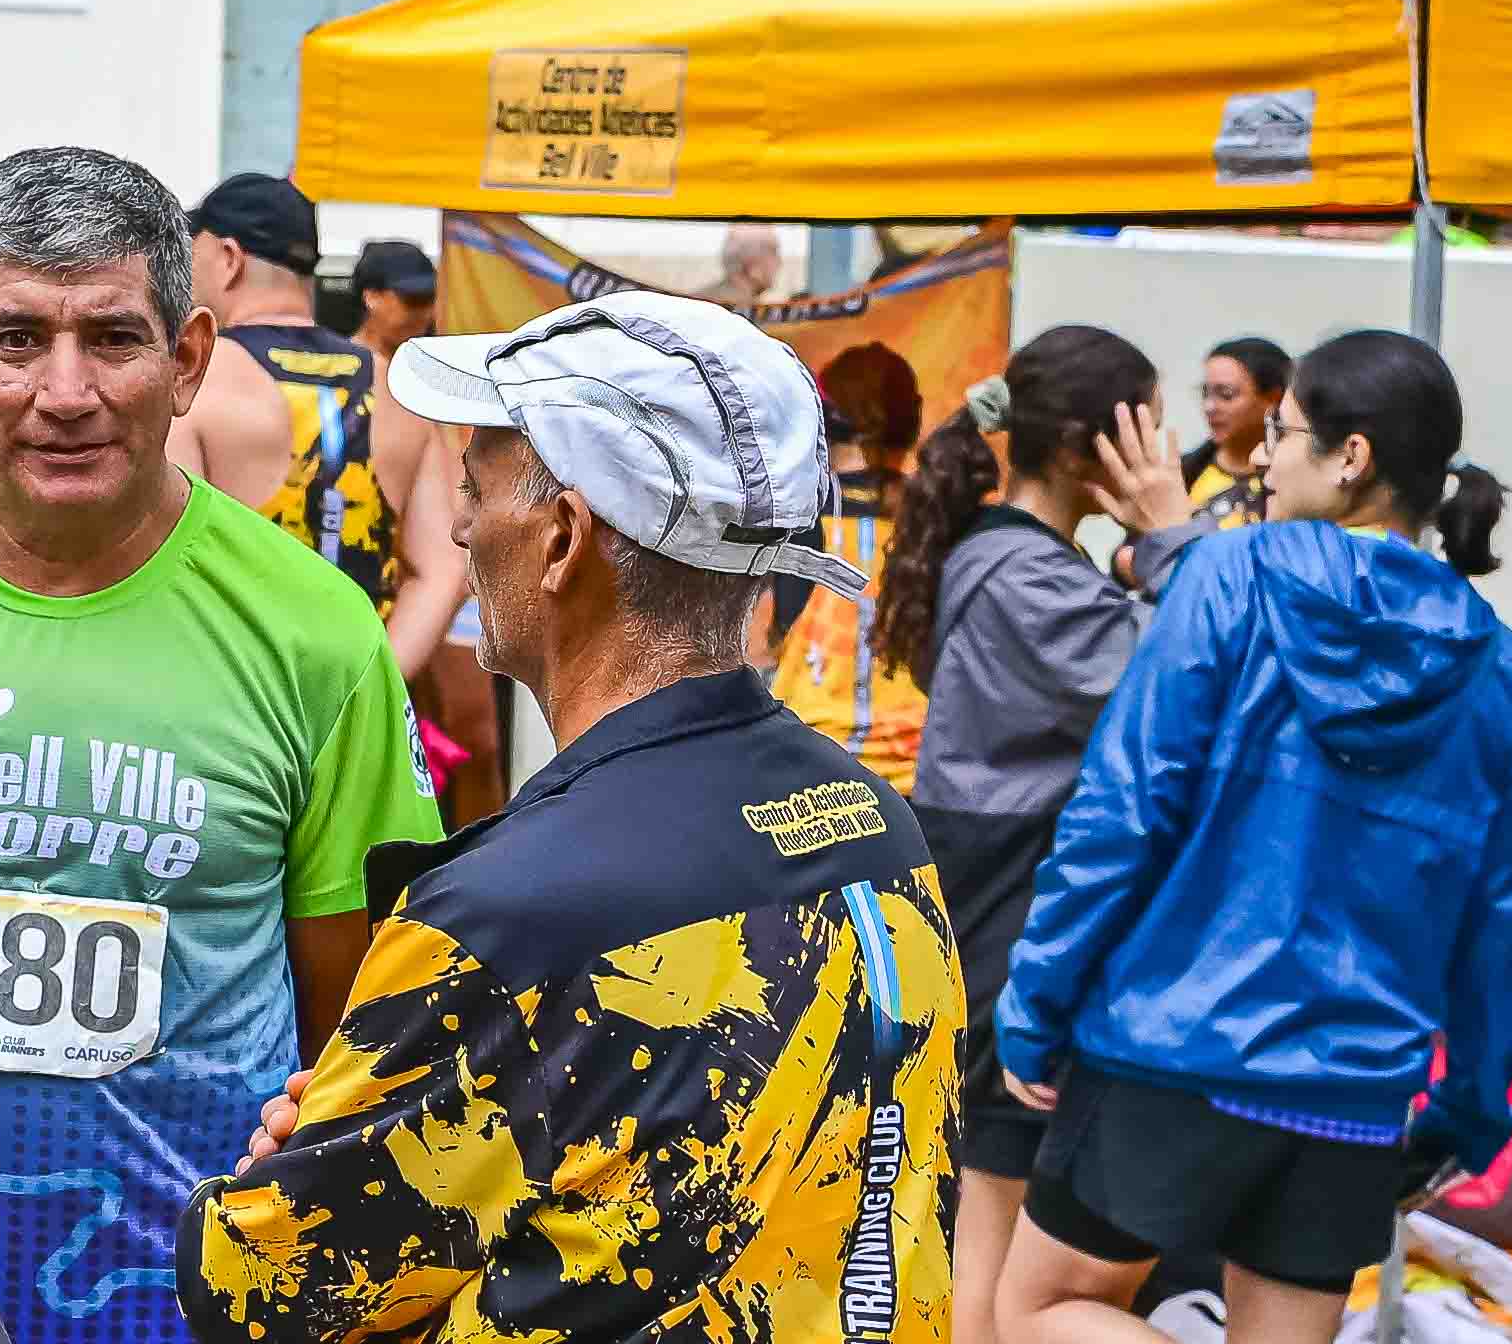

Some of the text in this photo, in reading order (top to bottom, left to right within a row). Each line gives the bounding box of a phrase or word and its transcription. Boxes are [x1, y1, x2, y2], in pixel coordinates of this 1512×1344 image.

[541, 56, 627, 95] Centro de
[495, 98, 593, 135] Actividades
[538, 142, 619, 181] Bell Ville
[88, 738, 208, 832] Ville
[746, 782, 875, 829] Centro de Actividades
[775, 809, 884, 853] Atléticas Bell Ville
[64, 1045, 134, 1063] CARUSO
[867, 1103, 903, 1188] CLUB
[844, 1189, 894, 1336] TRAINING
